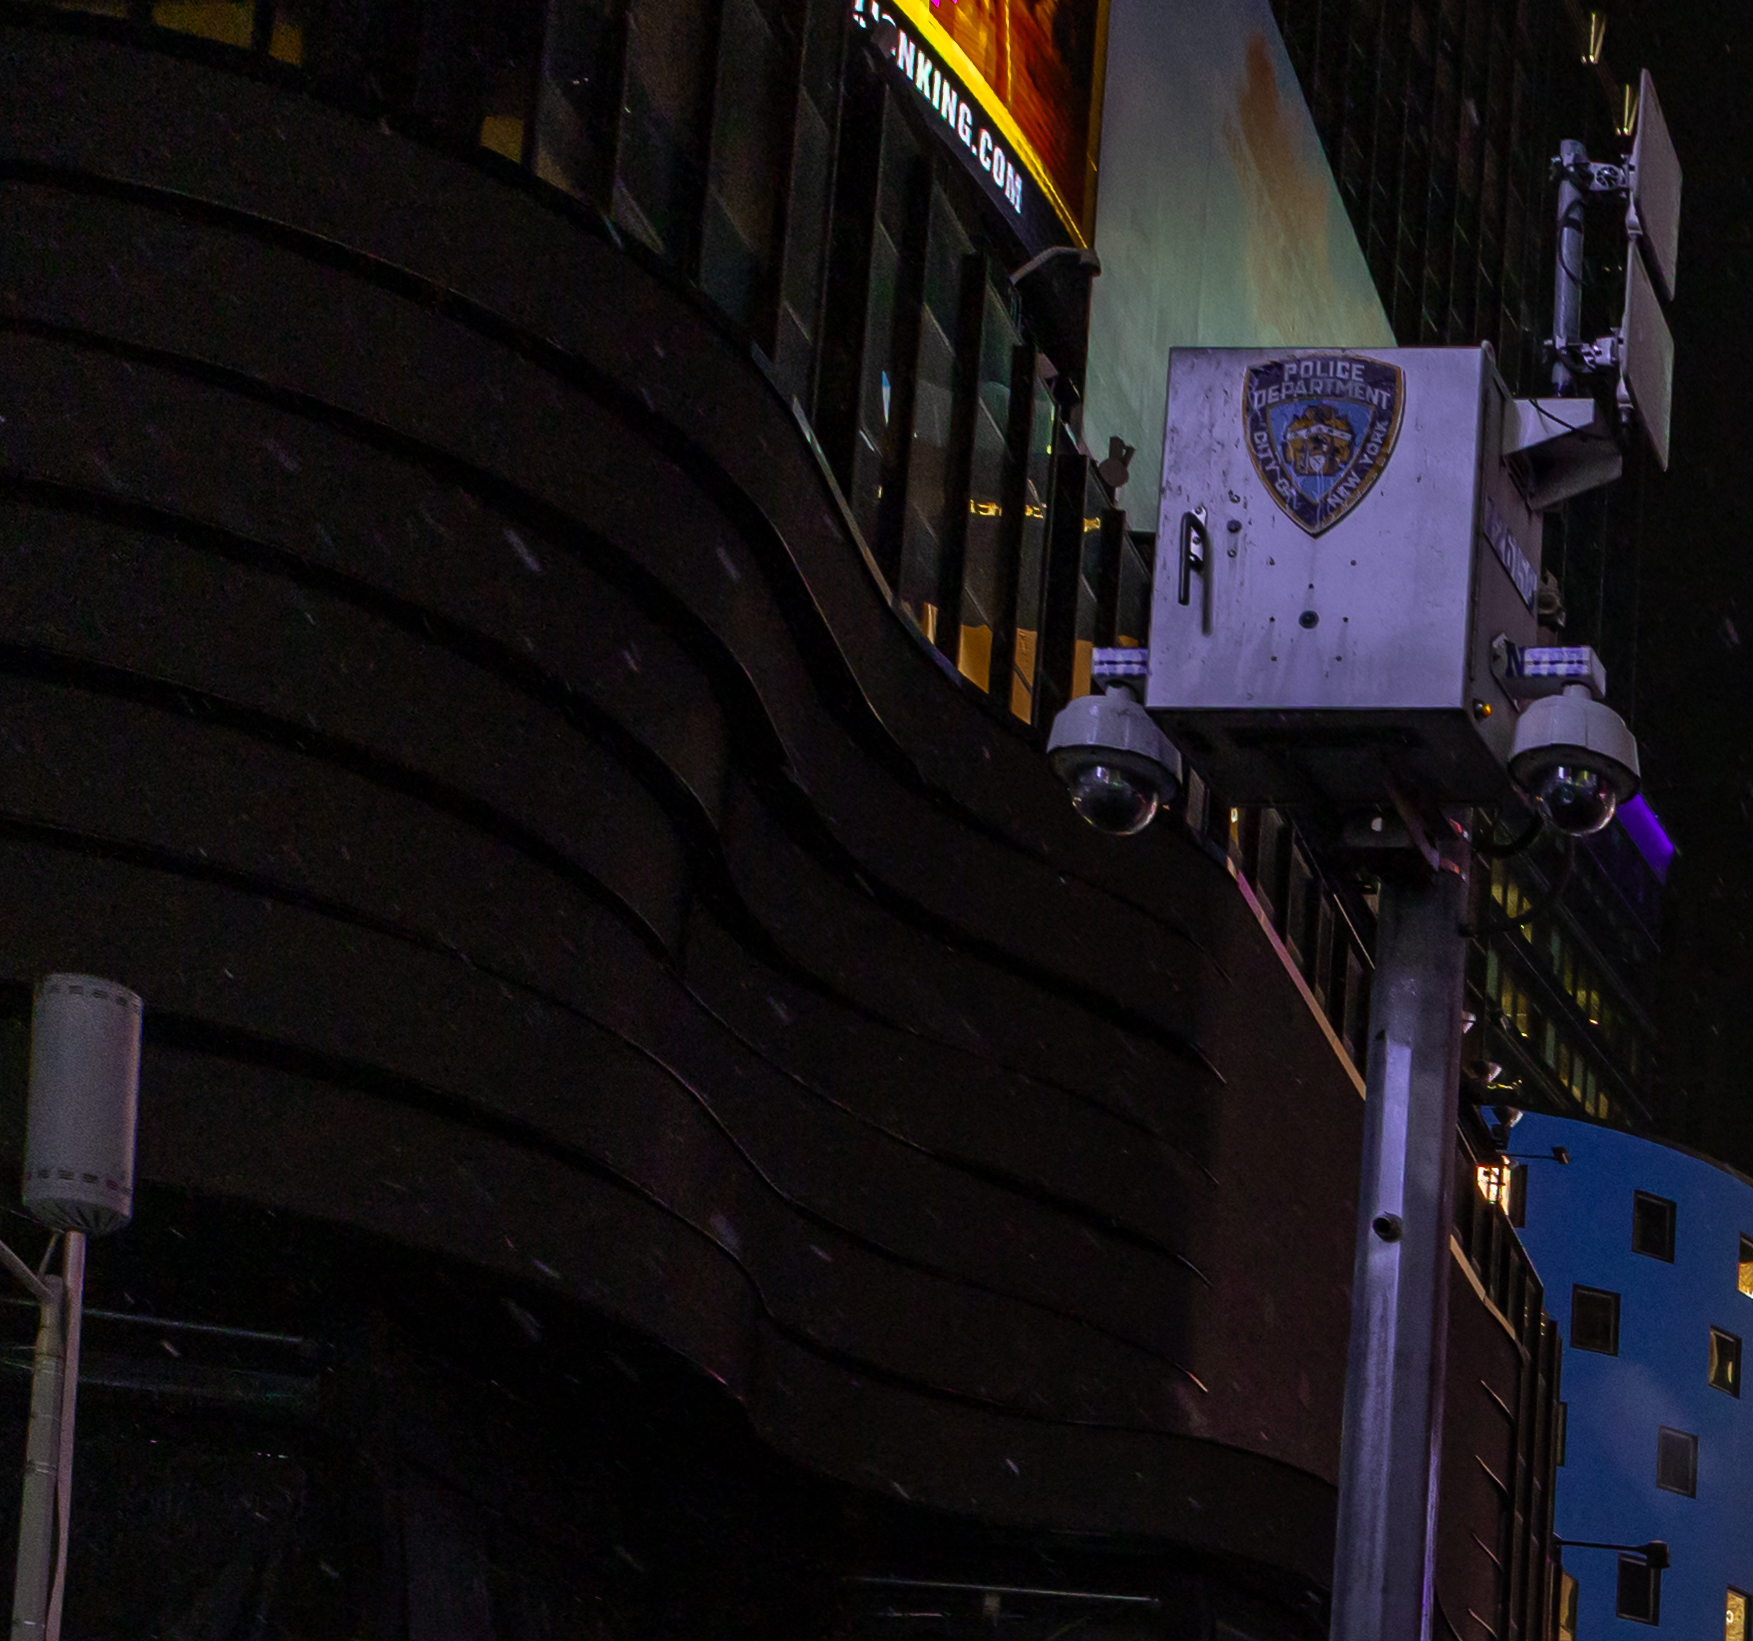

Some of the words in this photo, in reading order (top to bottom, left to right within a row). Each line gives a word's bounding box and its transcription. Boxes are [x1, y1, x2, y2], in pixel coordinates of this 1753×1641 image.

[1284, 361, 1365, 382] POLICE
[1251, 378, 1391, 410] DEPARTMENT
[1253, 431, 1280, 472] CITY
[1327, 471, 1361, 509] NEW
[1359, 420, 1390, 465] YORK
